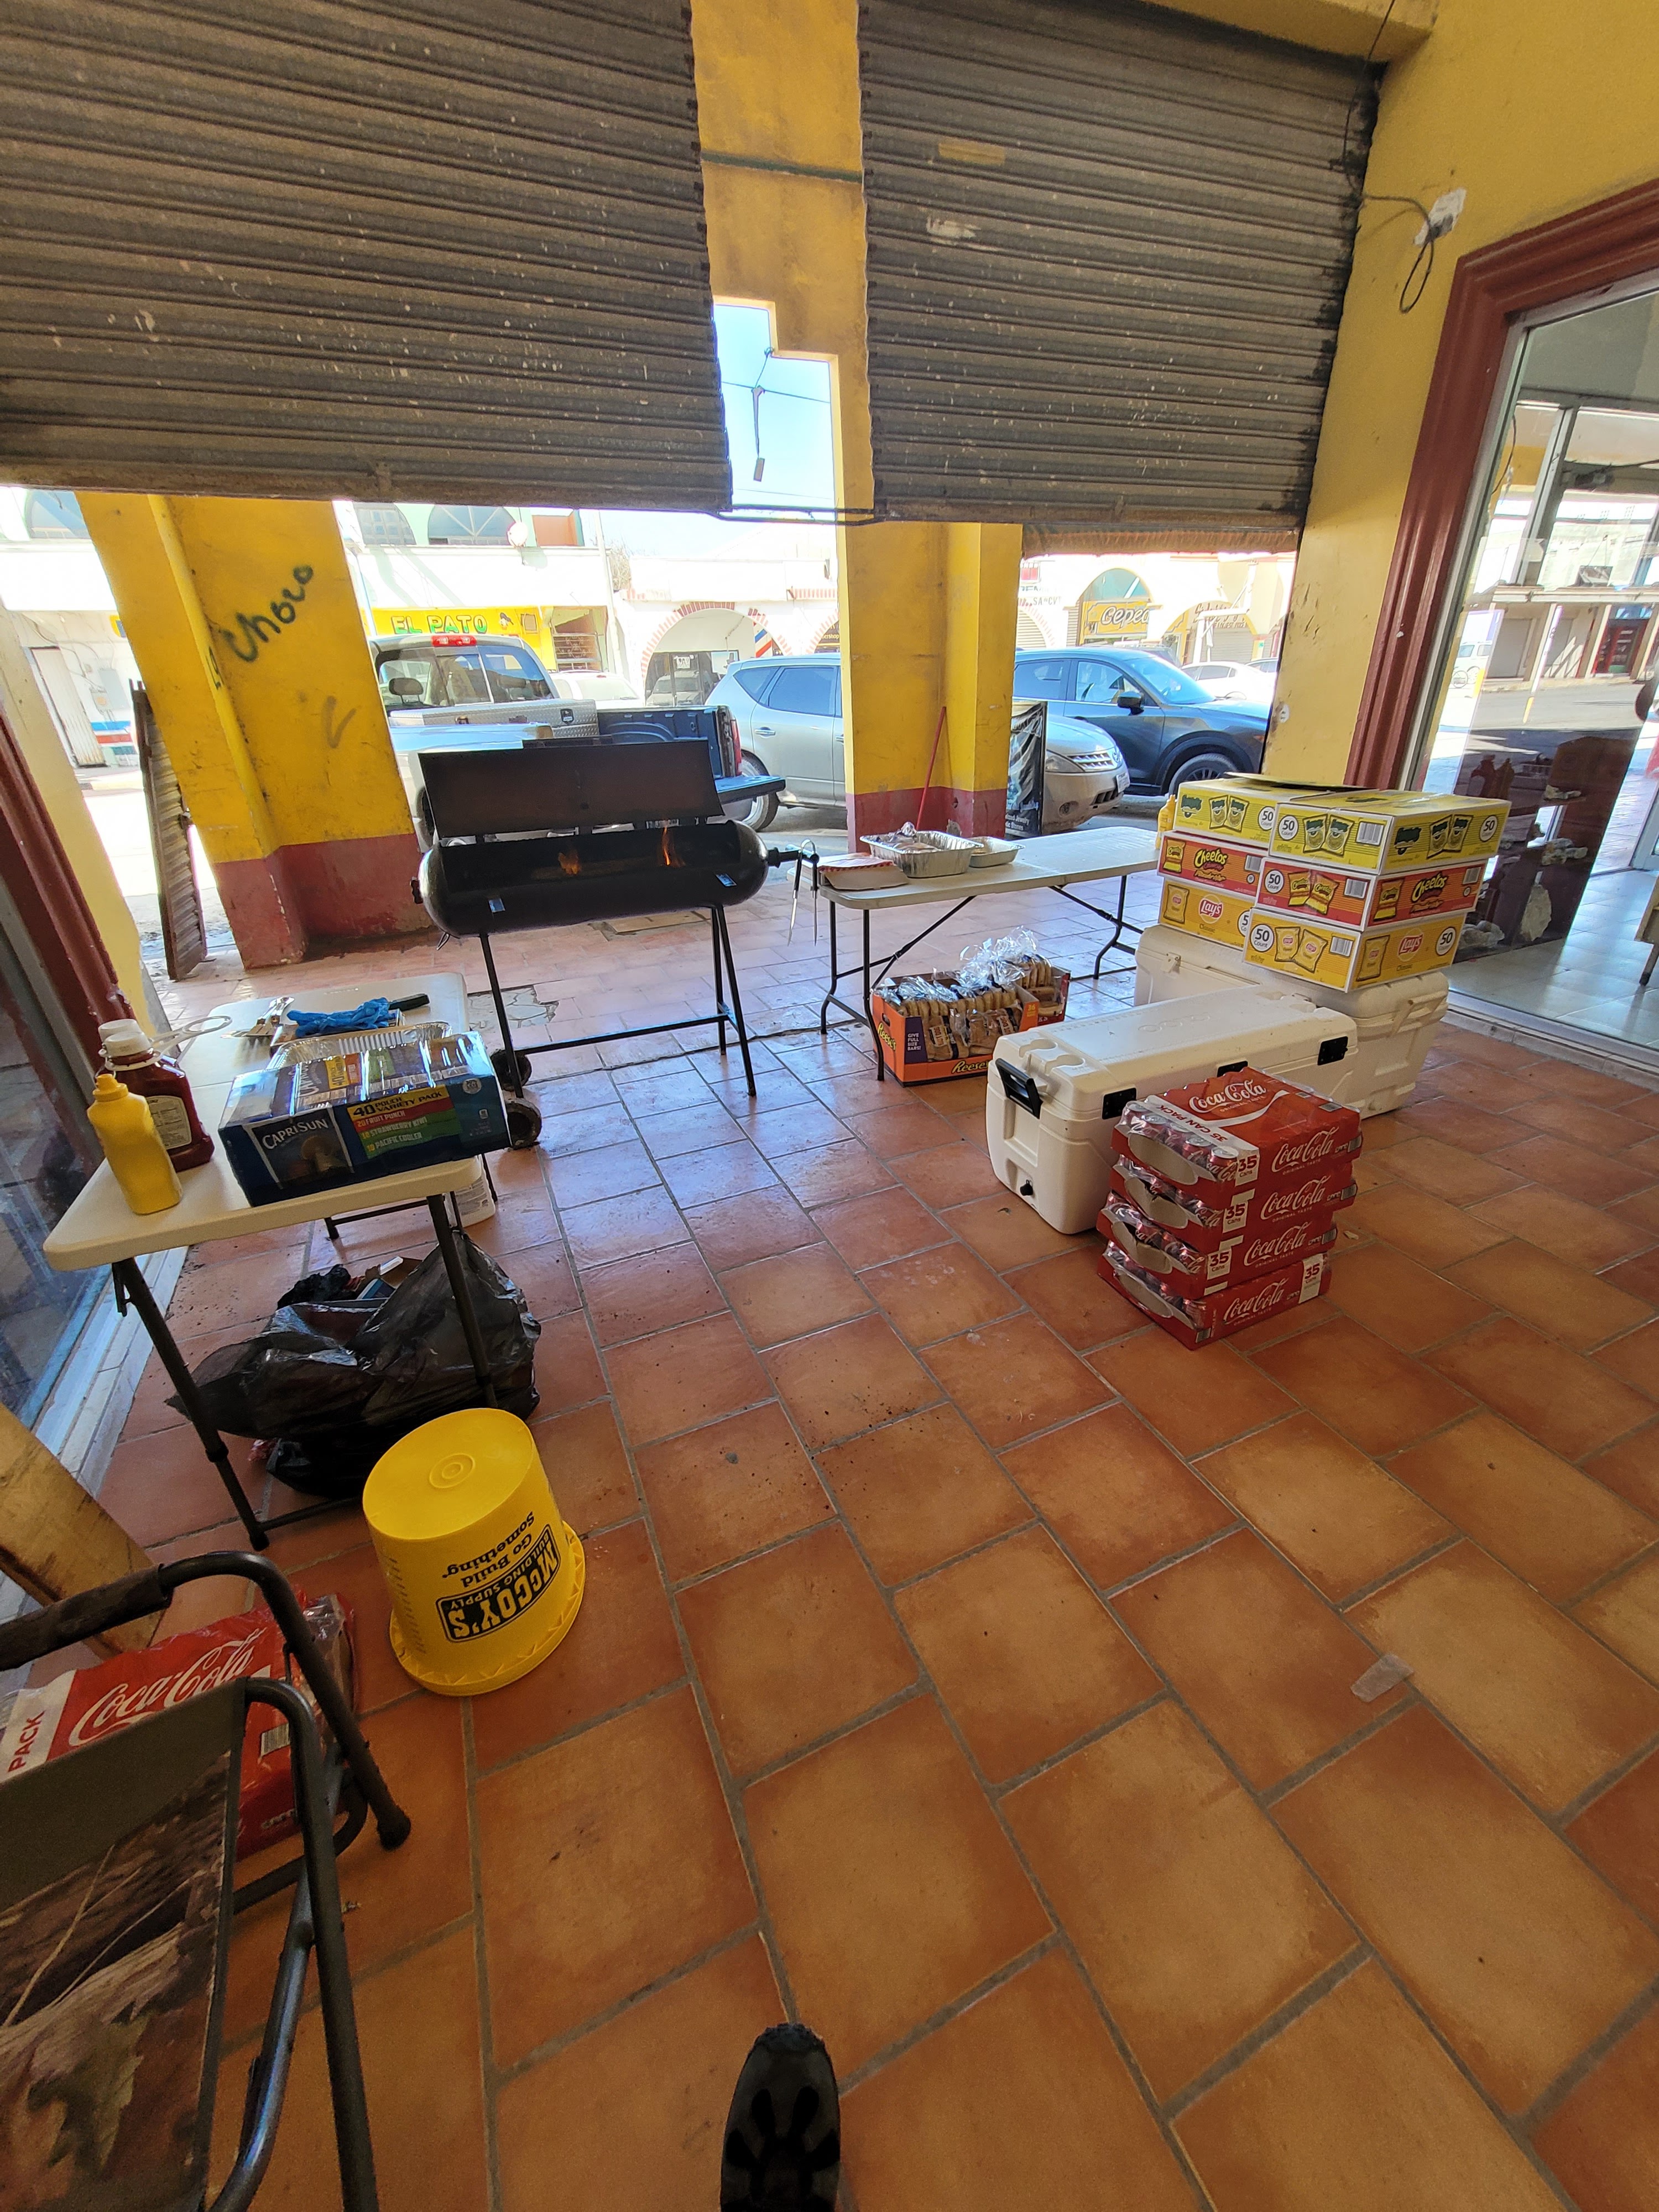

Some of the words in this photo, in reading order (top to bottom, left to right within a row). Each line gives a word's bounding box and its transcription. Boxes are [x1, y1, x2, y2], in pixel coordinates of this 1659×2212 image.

[391, 615, 422, 634] EL
[427, 614, 488, 634] PATO
[1262, 811, 1274, 821] 50
[1282, 818, 1295, 831] 50
[1483, 820, 1495, 832] 50
[1194, 848, 1228, 868] Cheetos
[1268, 874, 1281, 885] 50
[1411, 873, 1448, 902] Cheetos
[1242, 915, 1249, 926] 5
[1255, 928, 1270, 942] 50
[1439, 932, 1453, 946] 50
[877, 1022, 896, 1051] Reese's
[353, 1104, 376, 1117] 40
[374, 1097, 402, 1108] POUCH
[375, 1099, 415, 1113] VARIETY
[418, 1091, 443, 1103] PACK
[366, 1114, 384, 1126] FRUIT
[384, 1110, 406, 1120] PUNCH
[1155, 1105, 1187, 1121] PACK
[1185, 1120, 1211, 1134] CAN
[374, 1136, 399, 1149] PACIFIC
[398, 1132, 423, 1144] COOLER
[1209, 1133, 1228, 1142] 35
[1238, 1155, 1258, 1172] 35
[1225, 1203, 1245, 1219] 35
[1227, 1217, 1241, 1225] Cans
[1209, 1251, 1229, 1267] 35
[1212, 1264, 1225, 1272] Cans
[1305, 1263, 1320, 1280] 35
[513, 1533, 532, 1556] Go
[503, 1532, 549, 1585] BUILDING
[461, 1553, 511, 1588] Build
[451, 1585, 500, 1609] SUPPLY
[7, 1710, 46, 1772] PACK
